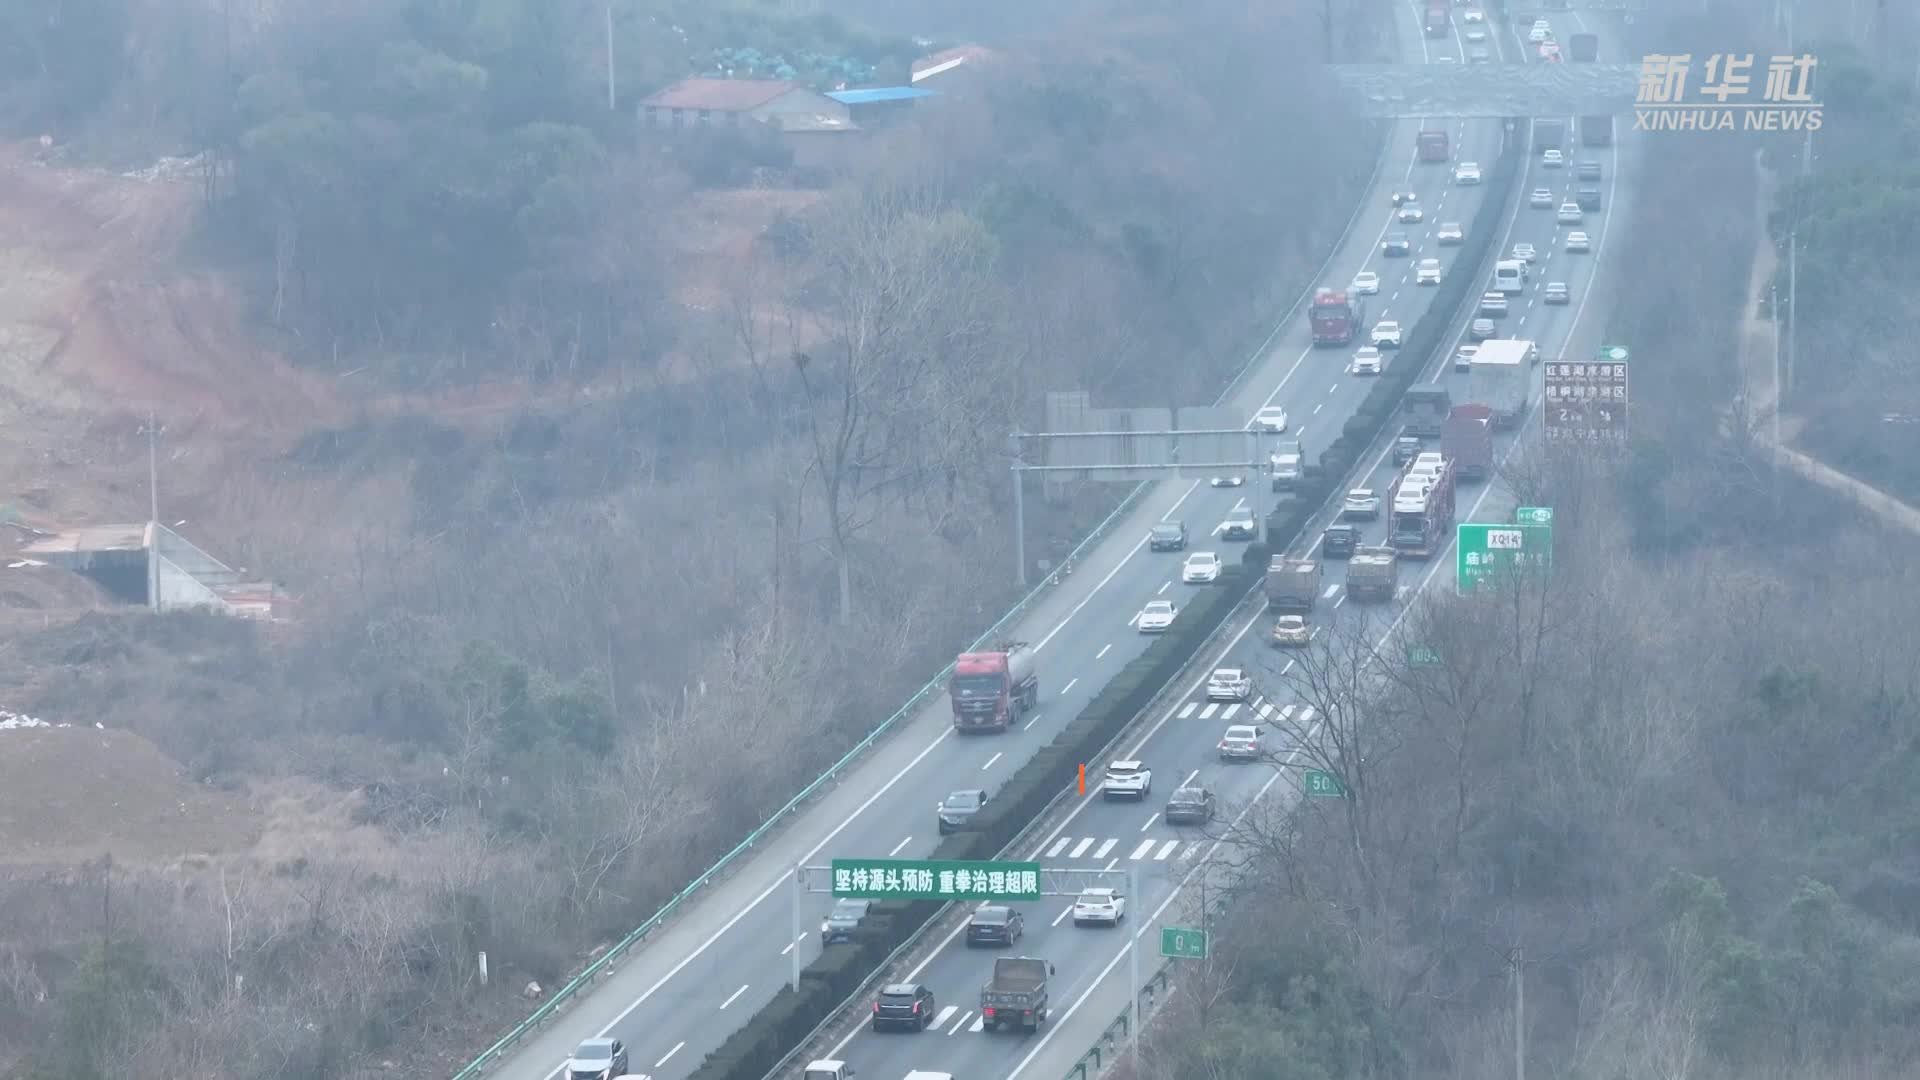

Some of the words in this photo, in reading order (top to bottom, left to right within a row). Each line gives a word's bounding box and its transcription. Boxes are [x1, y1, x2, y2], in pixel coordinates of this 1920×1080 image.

[1312, 775, 1330, 791] 50
[835, 868, 934, 892] 坚持源头预防
[938, 869, 1037, 894] 重拳治理超限
[1175, 935, 1184, 951] 0
